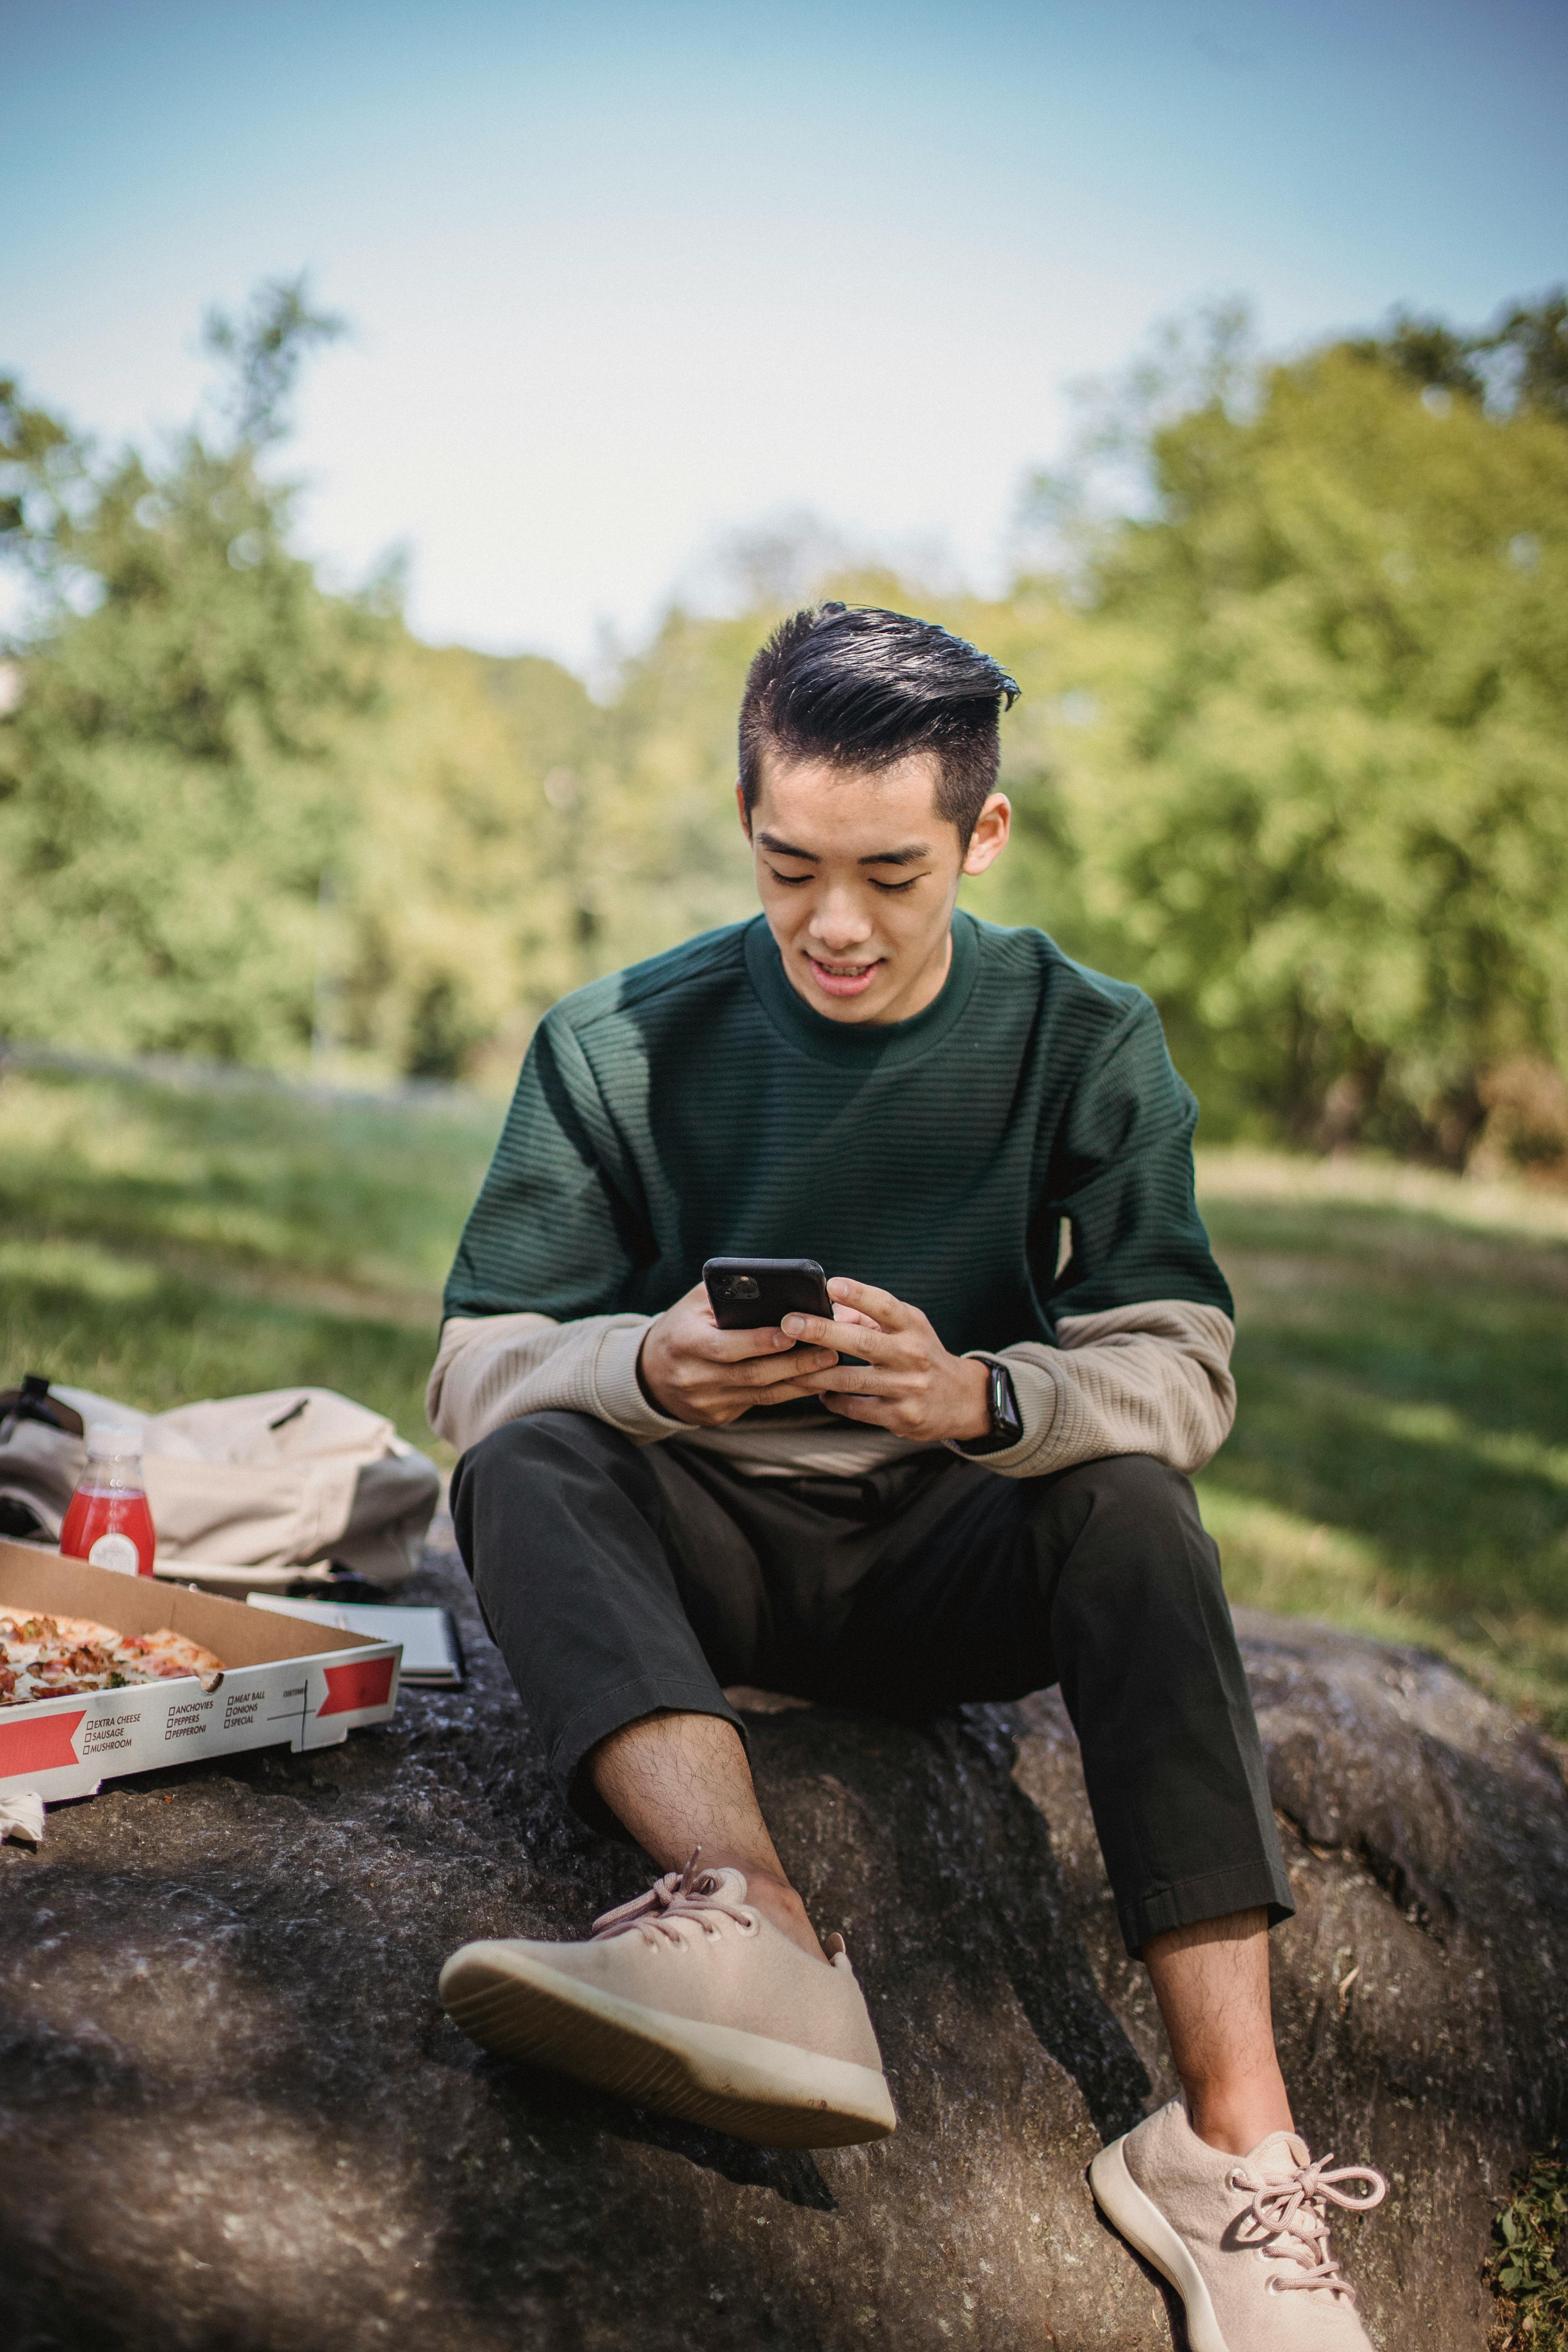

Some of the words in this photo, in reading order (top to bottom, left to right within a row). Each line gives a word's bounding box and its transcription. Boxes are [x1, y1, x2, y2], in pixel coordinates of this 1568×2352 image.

[234, 1693, 250, 1704] MEAT
[252, 1691, 265, 1700] BALL
[175, 1701, 213, 1714] ANCHOVIES
[232, 1703, 258, 1715] ONIONS
[94, 1718, 114, 1728] EXTRA
[117, 1713, 141, 1724] CHEESE
[174, 1714, 200, 1726] PEPPERS
[230, 1715, 253, 1727] SPECIAL
[92, 1728, 124, 1740] SAUSAGE
[172, 1724, 206, 1738] PEPPERONI
[90, 1739, 132, 1753] MUSHROOM
